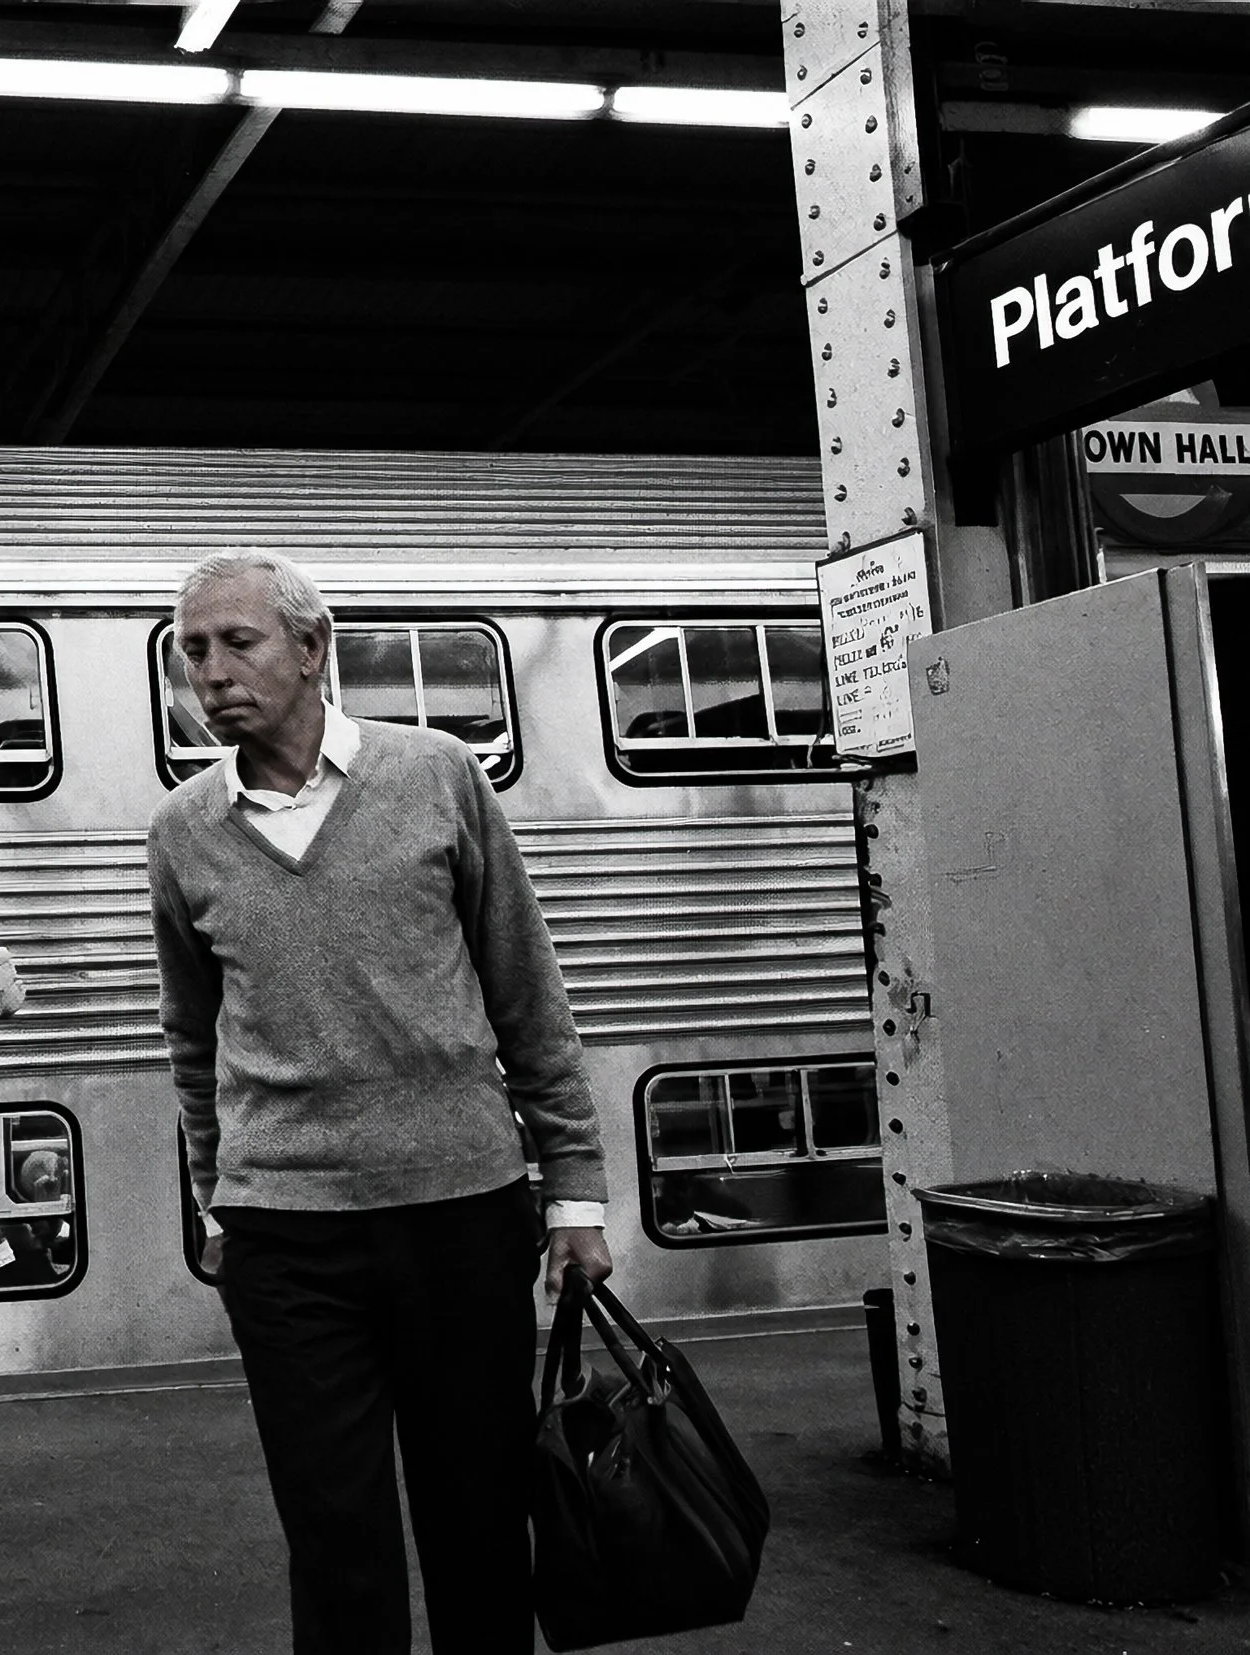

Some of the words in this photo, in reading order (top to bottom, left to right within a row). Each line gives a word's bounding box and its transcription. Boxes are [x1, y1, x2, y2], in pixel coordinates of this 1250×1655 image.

[990, 194, 1250, 368] Platfor
[1083, 430, 1162, 464] OWN
[1174, 433, 1250, 464] HALL
